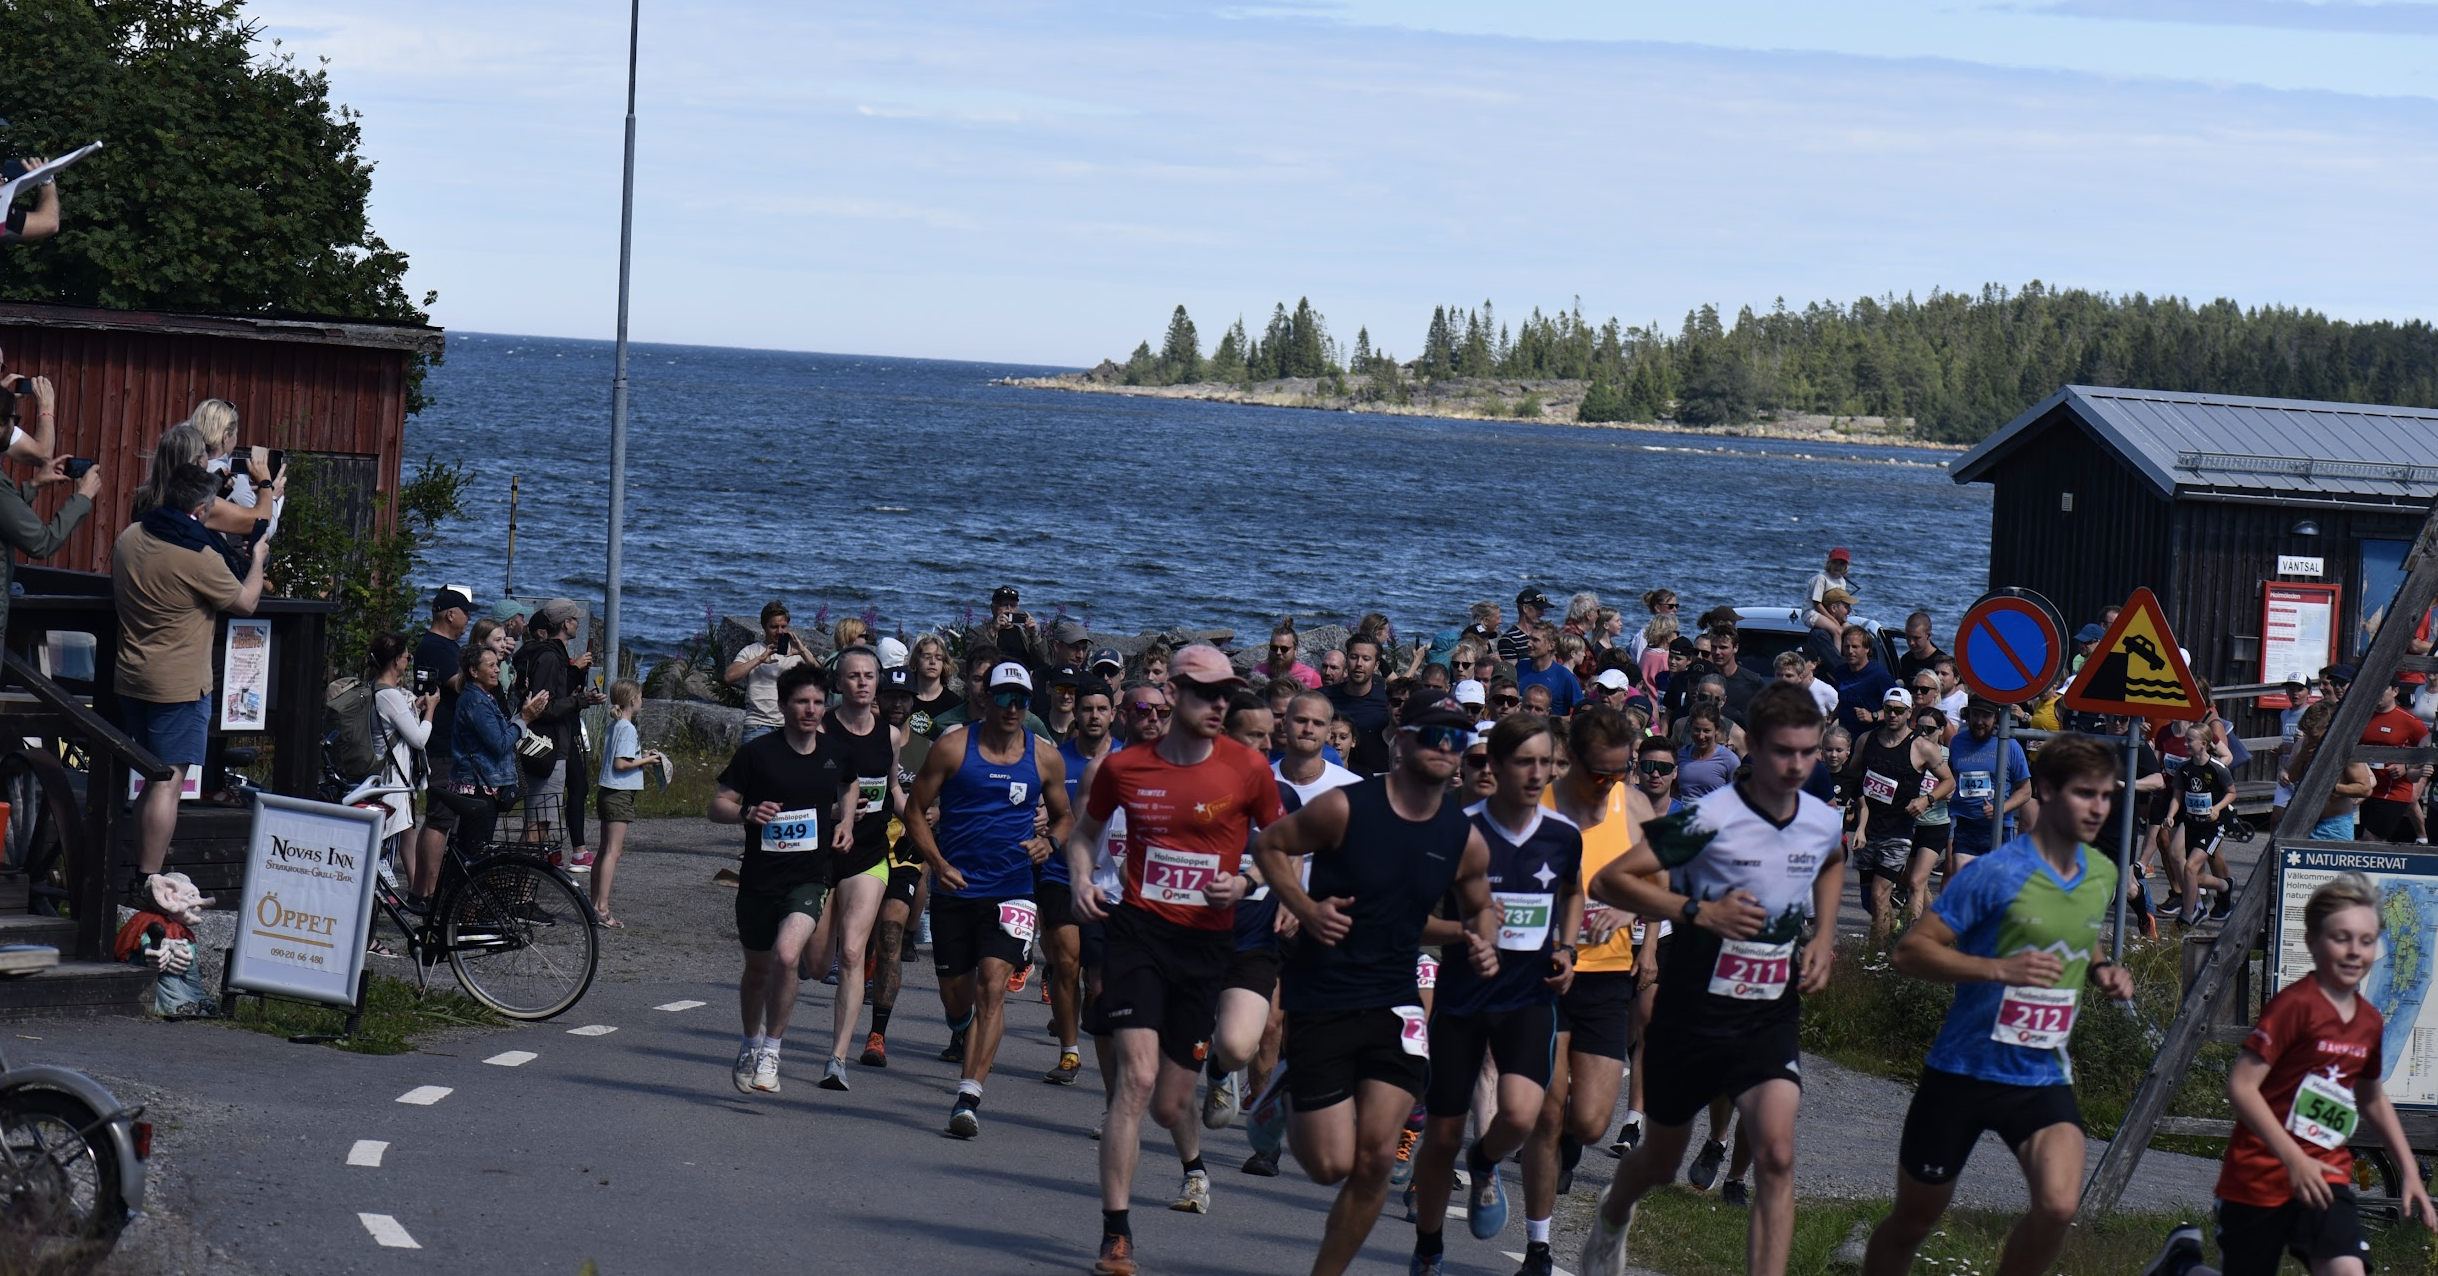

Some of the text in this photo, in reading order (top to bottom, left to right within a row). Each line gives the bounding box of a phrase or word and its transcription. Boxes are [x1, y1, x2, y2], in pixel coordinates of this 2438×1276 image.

[2282, 558, 2320, 573] VÄNTSAL
[892, 671, 906, 682] U
[1867, 779, 1889, 796] 245
[1964, 779, 1984, 789] 442
[1136, 788, 1167, 797] TRIMTEX
[2187, 800, 2206, 809] 344
[769, 812, 810, 822] olmöloppet
[771, 823, 807, 840] 349
[270, 834, 355, 871] NOVAS INN
[1154, 852, 1209, 866] Holmöloppet
[1787, 852, 1816, 864] cadre
[2305, 852, 2408, 870] NATURRESERVAT
[1156, 866, 1203, 890] 217
[2286, 871, 2335, 882] Välkommen
[1172, 892, 1190, 900] PURE
[256, 890, 337, 936] ÖPPET
[1009, 909, 1036, 931] 225
[1504, 909, 1535, 924] 737
[270, 947, 324, 965] 090-20 66 480
[1729, 959, 1779, 983] 211
[2012, 1005, 2063, 1032] 212
[2305, 1098, 2348, 1132] 546
